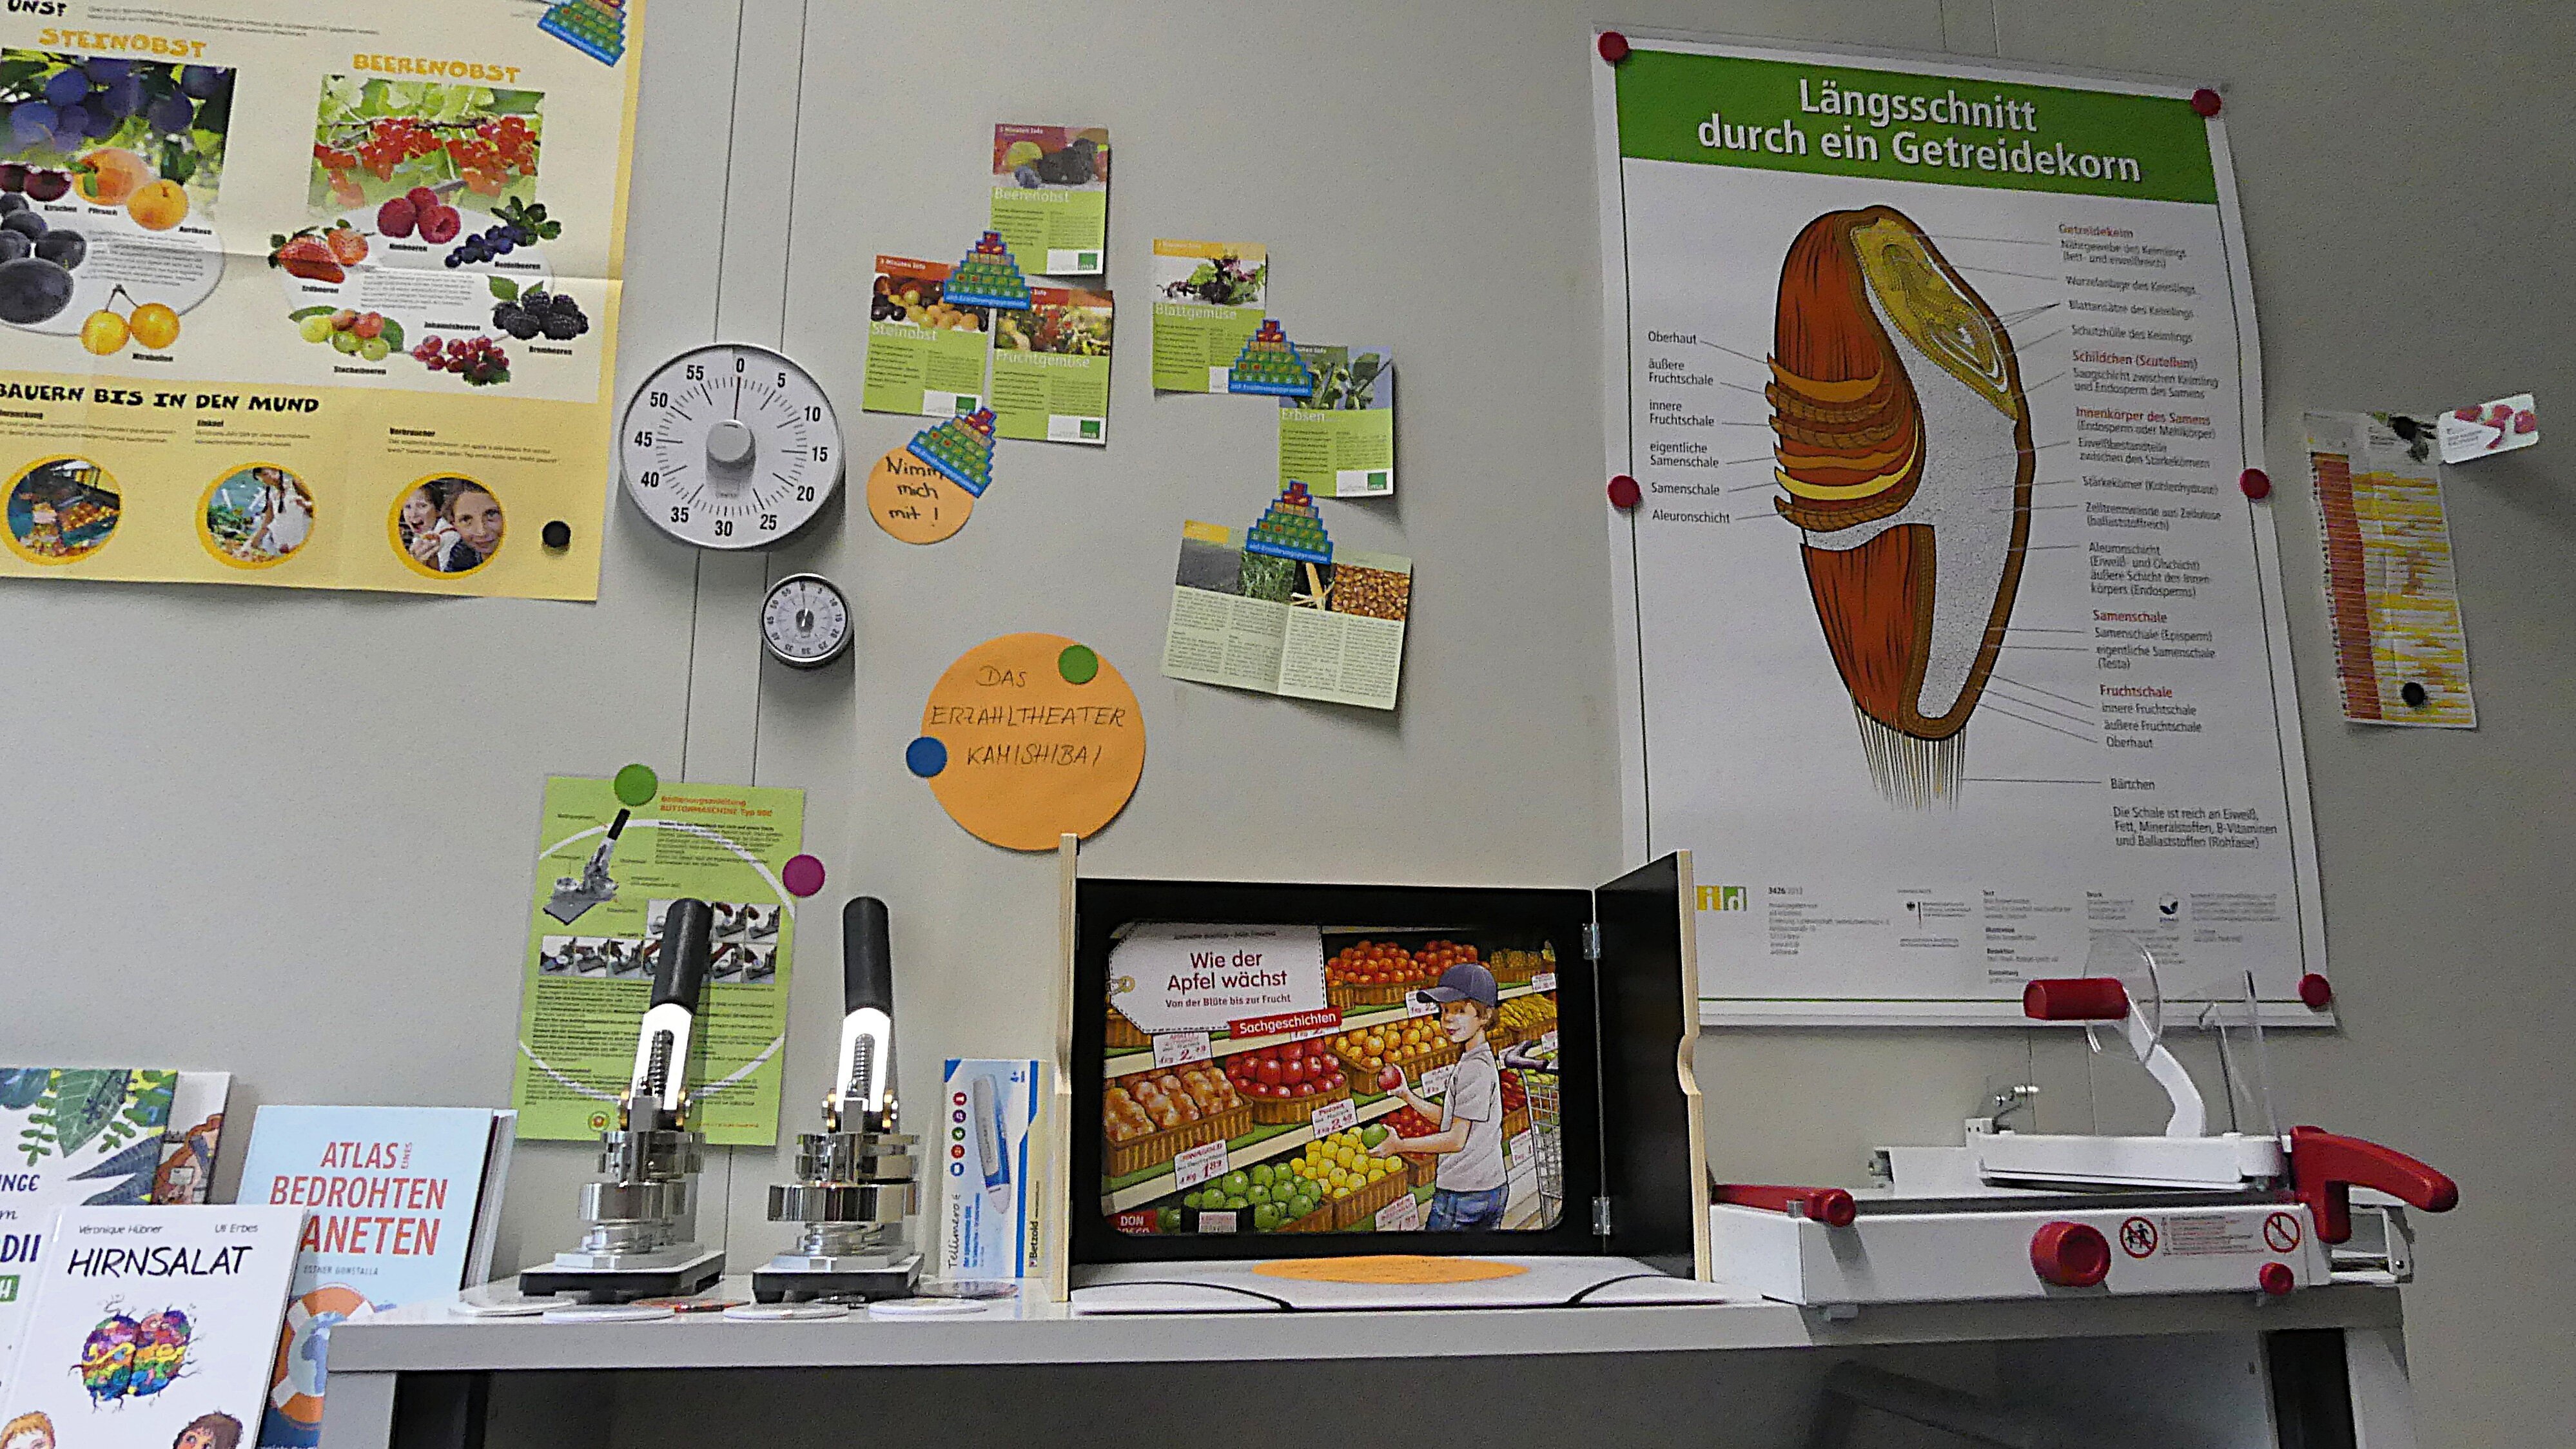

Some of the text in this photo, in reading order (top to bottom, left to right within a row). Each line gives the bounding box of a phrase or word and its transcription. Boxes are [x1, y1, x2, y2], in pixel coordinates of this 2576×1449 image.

[38, 28, 208, 59] STEINOBST
[352, 53, 521, 84] BEERENOBST
[1800, 78, 2037, 132] Längsschnitt
[1698, 110, 2142, 182] durch ein Getreidekorn
[2059, 224, 2134, 238] Getreidekeim
[1648, 331, 1697, 344] Oberhaut
[736, 358, 745, 374] 0
[1648, 358, 1685, 371] äußere
[2073, 349, 2198, 370] Schildchen (Scutellum)
[686, 365, 704, 382] 55
[777, 373, 786, 388] 5
[1648, 372, 1714, 385] Fruchtschale
[2074, 382, 2093, 391] und
[2095, 382, 2148, 396] Endosperm
[93, 387, 144, 406] BIS
[153, 392, 188, 409] IN
[195, 394, 240, 410] DEN
[248, 396, 319, 413] MUND
[650, 392, 668, 409] 50
[1649, 400, 1683, 411] innere
[805, 407, 821, 423] 10
[1281, 409, 1325, 422] Erbsen
[1649, 413, 1715, 427] Fruchtschale
[2147, 411, 2165, 423] des
[2169, 413, 2210, 426] Samens
[634, 431, 652, 447] 45
[812, 447, 828, 462] 15
[1650, 442, 1708, 454] eigentliche
[1650, 454, 1719, 469] Samenschale
[641, 472, 659, 488] 40
[797, 486, 815, 502] 20
[897, 482, 939, 500] mich
[1651, 482, 1720, 496] Samenschale
[670, 507, 689, 523] 35
[888, 506, 921, 520] mit
[1652, 509, 1731, 524] Aleuronschicht
[714, 520, 733, 537] 30
[759, 514, 777, 532] 25
[2089, 542, 2160, 556] Aleuronschicht
[2132, 558, 2151, 568] und
[2127, 570, 2161, 582] Schicht
[2091, 582, 2127, 596] körpers
[2093, 610, 2167, 623] Samenschale
[2095, 627, 2160, 640] Samenschale
[2096, 645, 2216, 659] eigentliche Samenschale
[2098, 657, 2131, 670] (Testa)
[975, 665, 1028, 687] DAS
[2100, 684, 2173, 698] Fruchtschale
[2102, 703, 2197, 716] innere Fruchtschale
[2104, 719, 2202, 733] äußere Fruchtschale
[2106, 735, 2154, 748] Oberhaut
[968, 743, 1102, 766] KAMISHIBAI
[2111, 777, 2156, 791] Bärtchen
[2113, 806, 2129, 818] Die
[2132, 806, 2165, 819] Schale
[2167, 808, 2179, 819] ist
[2181, 807, 2205, 819] reich
[2208, 810, 2221, 819] an
[2114, 820, 2136, 833] Fett,
[2116, 835, 2135, 846] und
[1190, 950, 1263, 969] Wie der
[1167, 969, 1287, 995] Apfel wächst
[1166, 999, 1183, 1008] Von
[1186, 998, 1200, 1007] der
[1203, 997, 1228, 1007] Blüte
[1230, 996, 1243, 1005] bis
[1262, 994, 1291, 1004] Frucht
[1239, 1012, 1336, 1035] Sachgeschichten
[320, 1142, 399, 1169] ATLAS
[0, 1173, 41, 1192] NGE
[269, 1175, 448, 1210] BEDROHTEN
[1120, 1216, 1144, 1226] DON
[300, 1214, 440, 1256] ANETEN
[1029, 1221, 1039, 1259] Betzold
[67, 1245, 253, 1278] HIRNSALAT
